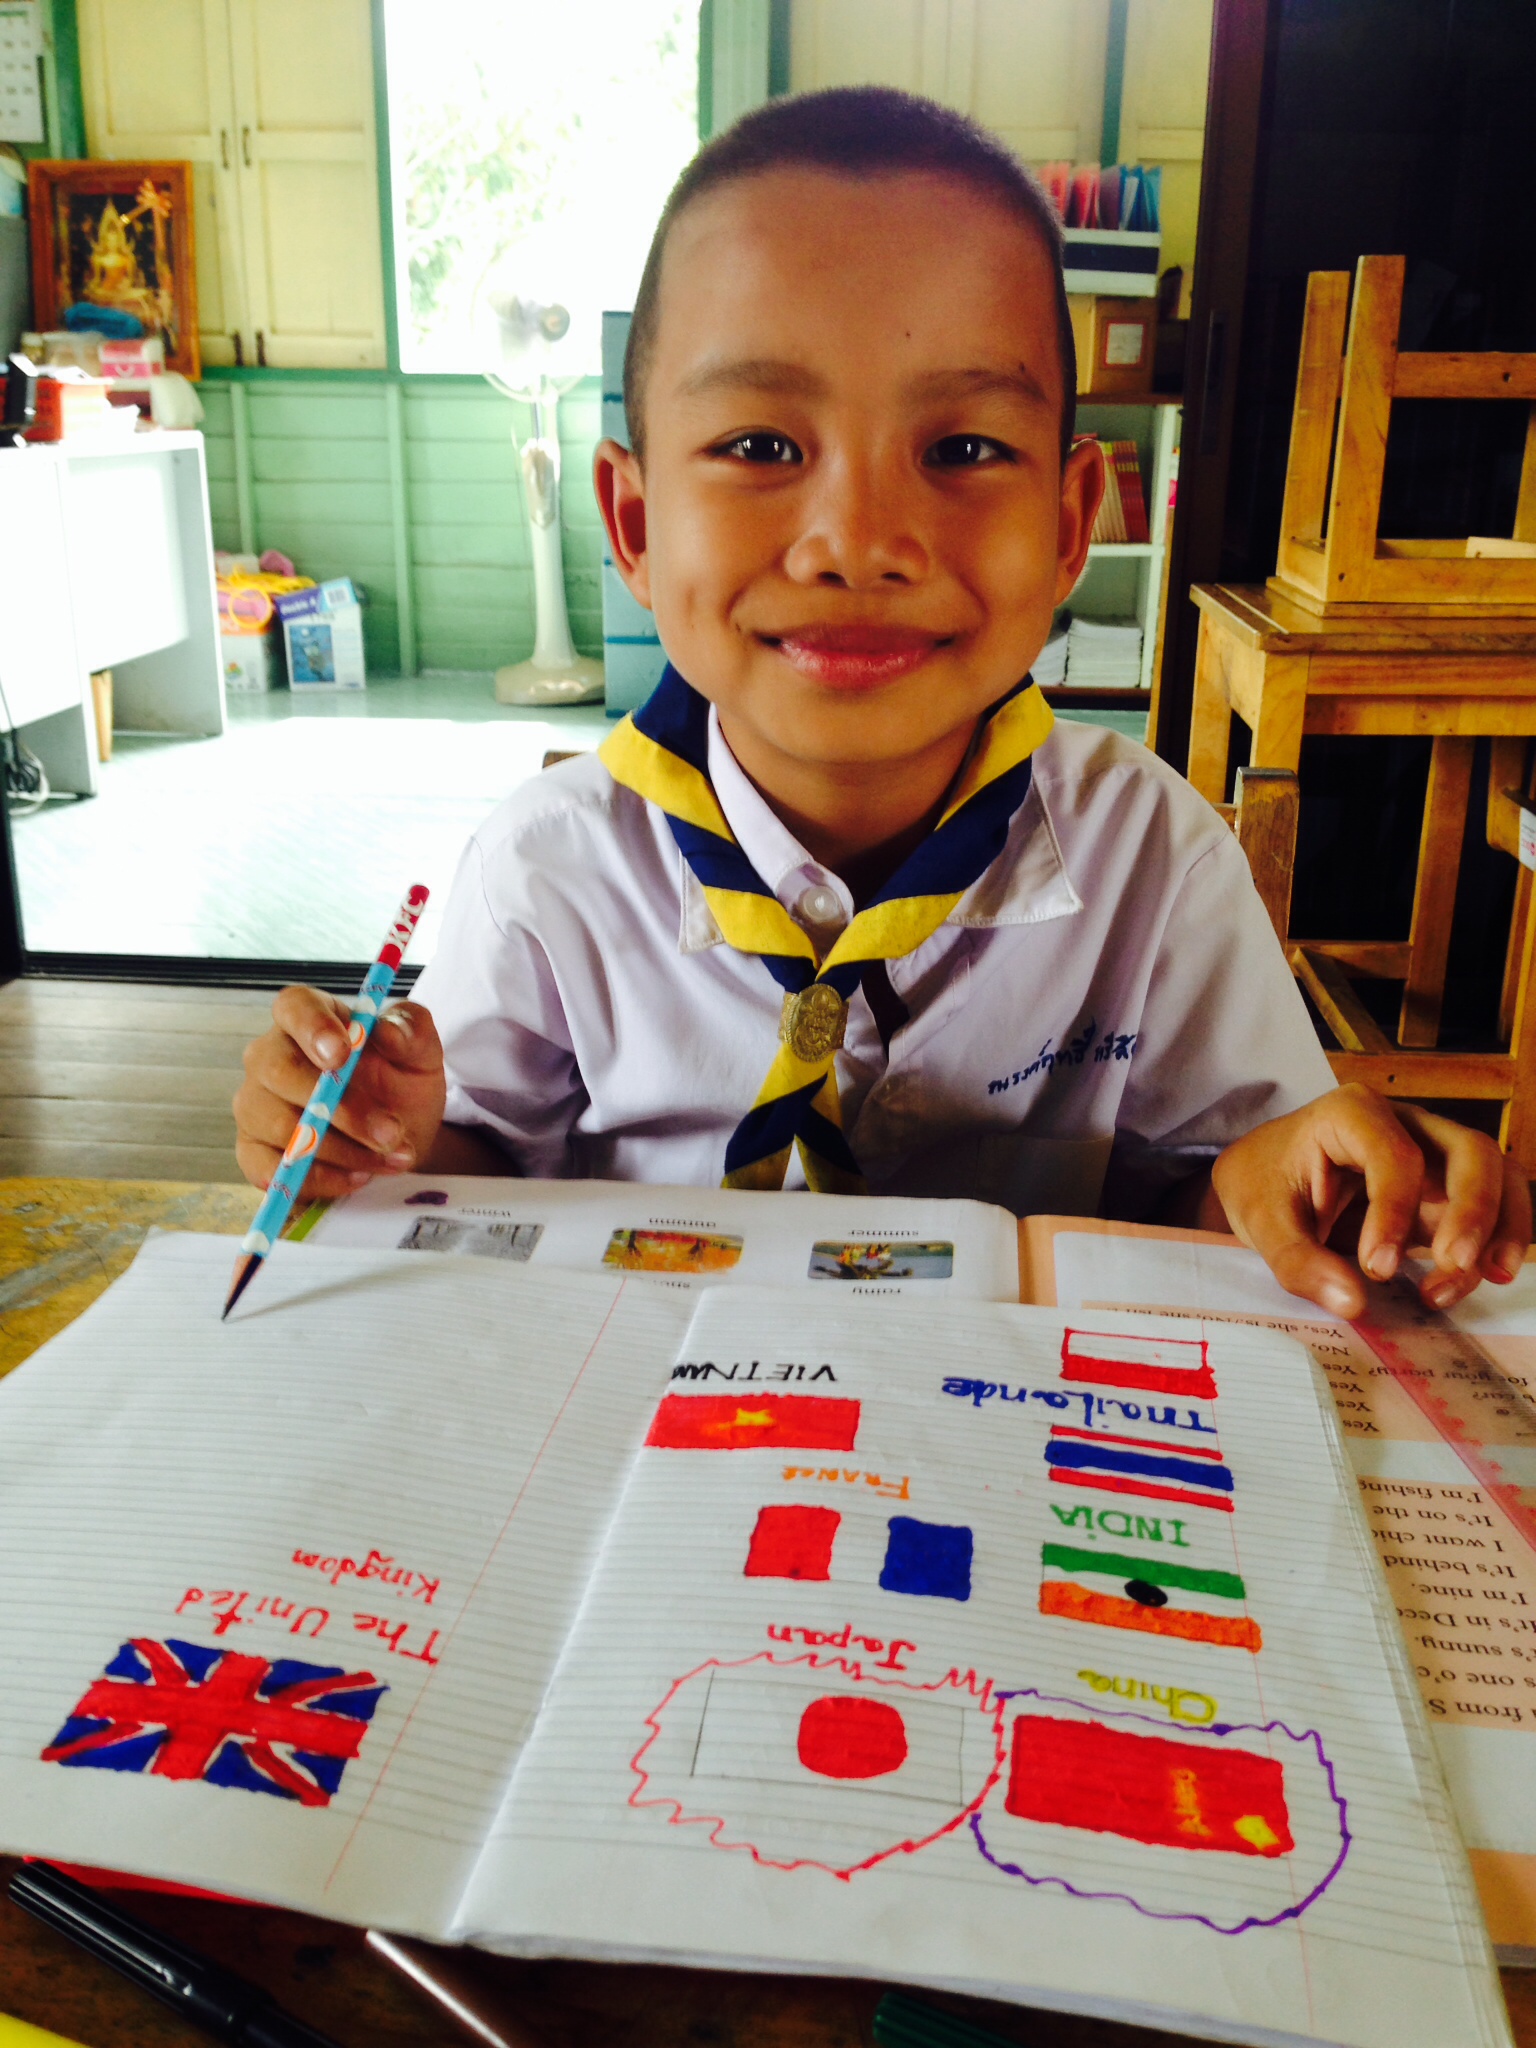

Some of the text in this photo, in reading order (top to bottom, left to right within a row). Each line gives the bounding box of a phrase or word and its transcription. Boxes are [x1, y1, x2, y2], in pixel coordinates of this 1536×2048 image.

[648, 1217, 716, 1229] autumn
[847, 1229, 919, 1238] summer
[852, 1286, 902, 1297] rainy
[1266, 1321, 1299, 1333] she
[1304, 1324, 1345, 1339] Yes,
[1311, 1342, 1351, 1356] No,
[1372, 1505, 1409, 1519] the
[1417, 1509, 1447, 1522] on
[1423, 1534, 1486, 1549] want
[1493, 1539, 1505, 1553] I
[1383, 1555, 1470, 1575] behind
[291, 1549, 441, 1606] Kingdom
[1410, 1583, 1473, 1601] nine.
[174, 1587, 441, 1667] The United
[1465, 1615, 1491, 1632] in
[766, 1622, 918, 1672] Japan
[1414, 1635, 1503, 1657] sunny.
[1465, 1672, 1515, 1687] one
[1454, 1701, 1523, 1724] from
